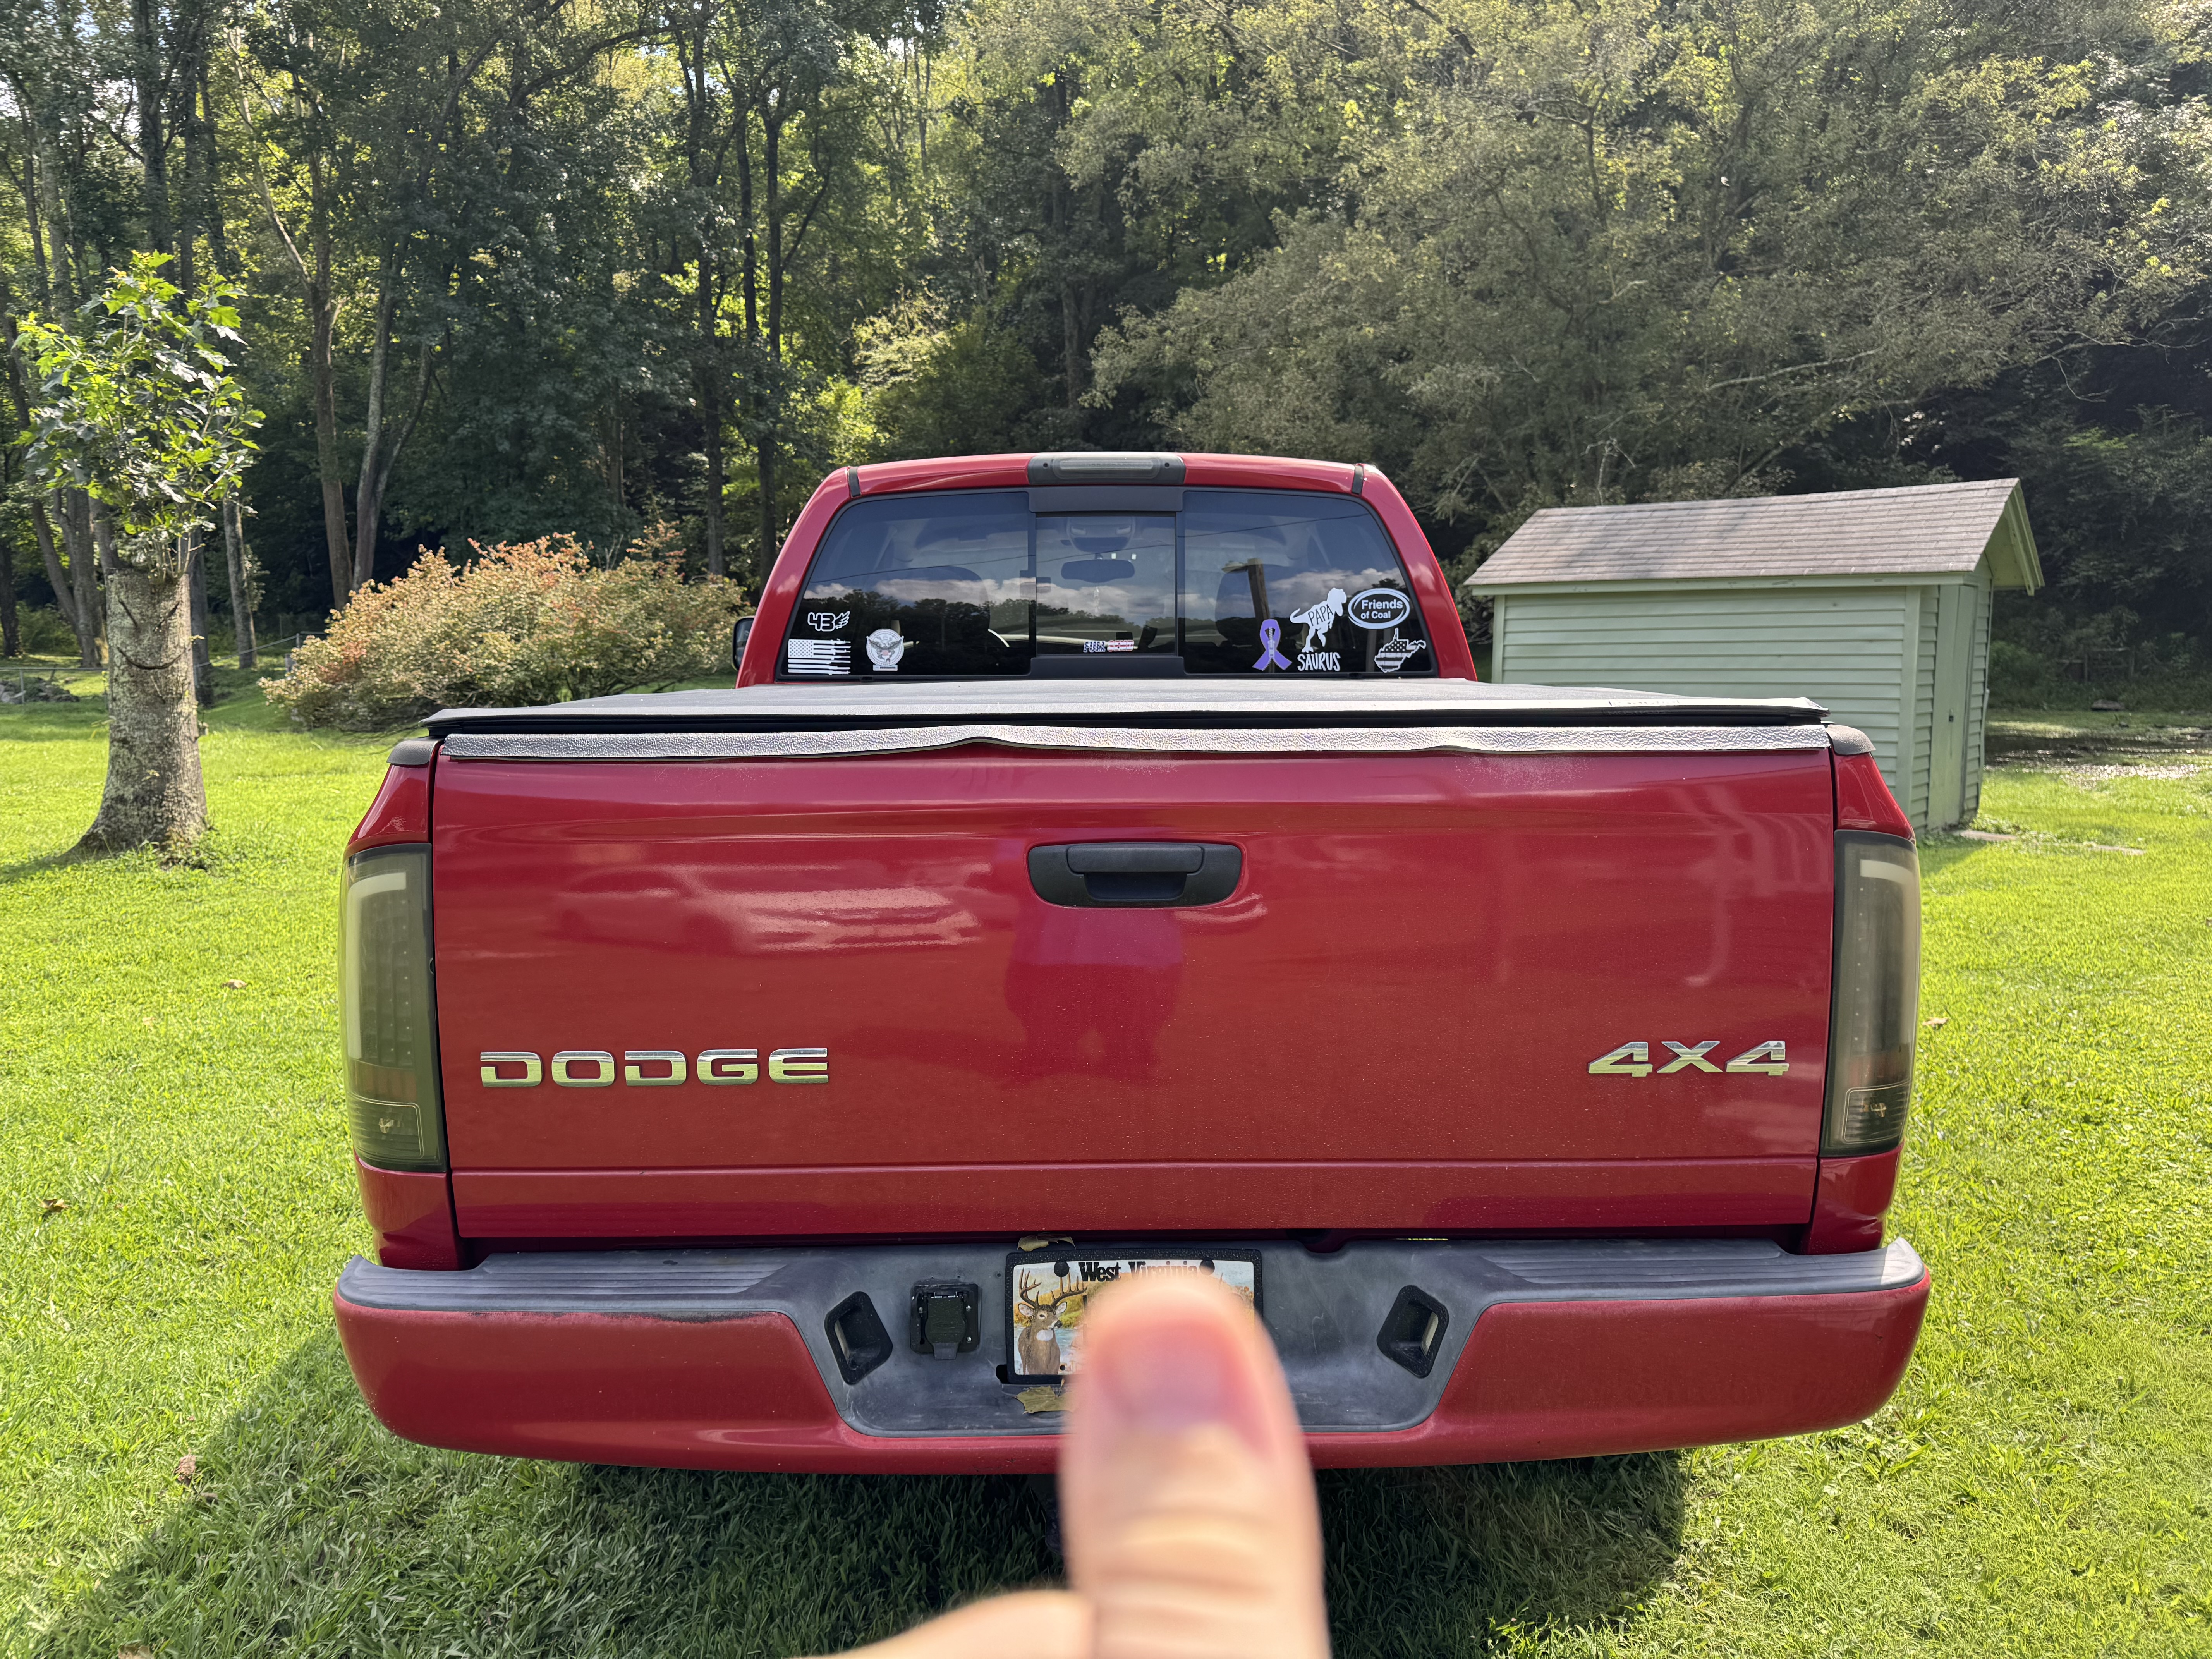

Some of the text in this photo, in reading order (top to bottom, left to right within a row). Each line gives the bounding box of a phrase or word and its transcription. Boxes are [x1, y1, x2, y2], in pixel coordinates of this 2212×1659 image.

[1360, 610, 1391, 619] of Coal
[1361, 599, 1403, 610] Friends
[807, 612, 835, 632] 43
[1308, 604, 1333, 626] PAPA
[1297, 652, 1341, 672] SAURUS
[480, 1048, 829, 1087] DODGE
[1588, 1041, 1789, 1077] 4X4
[1078, 1262, 1121, 1281] West
